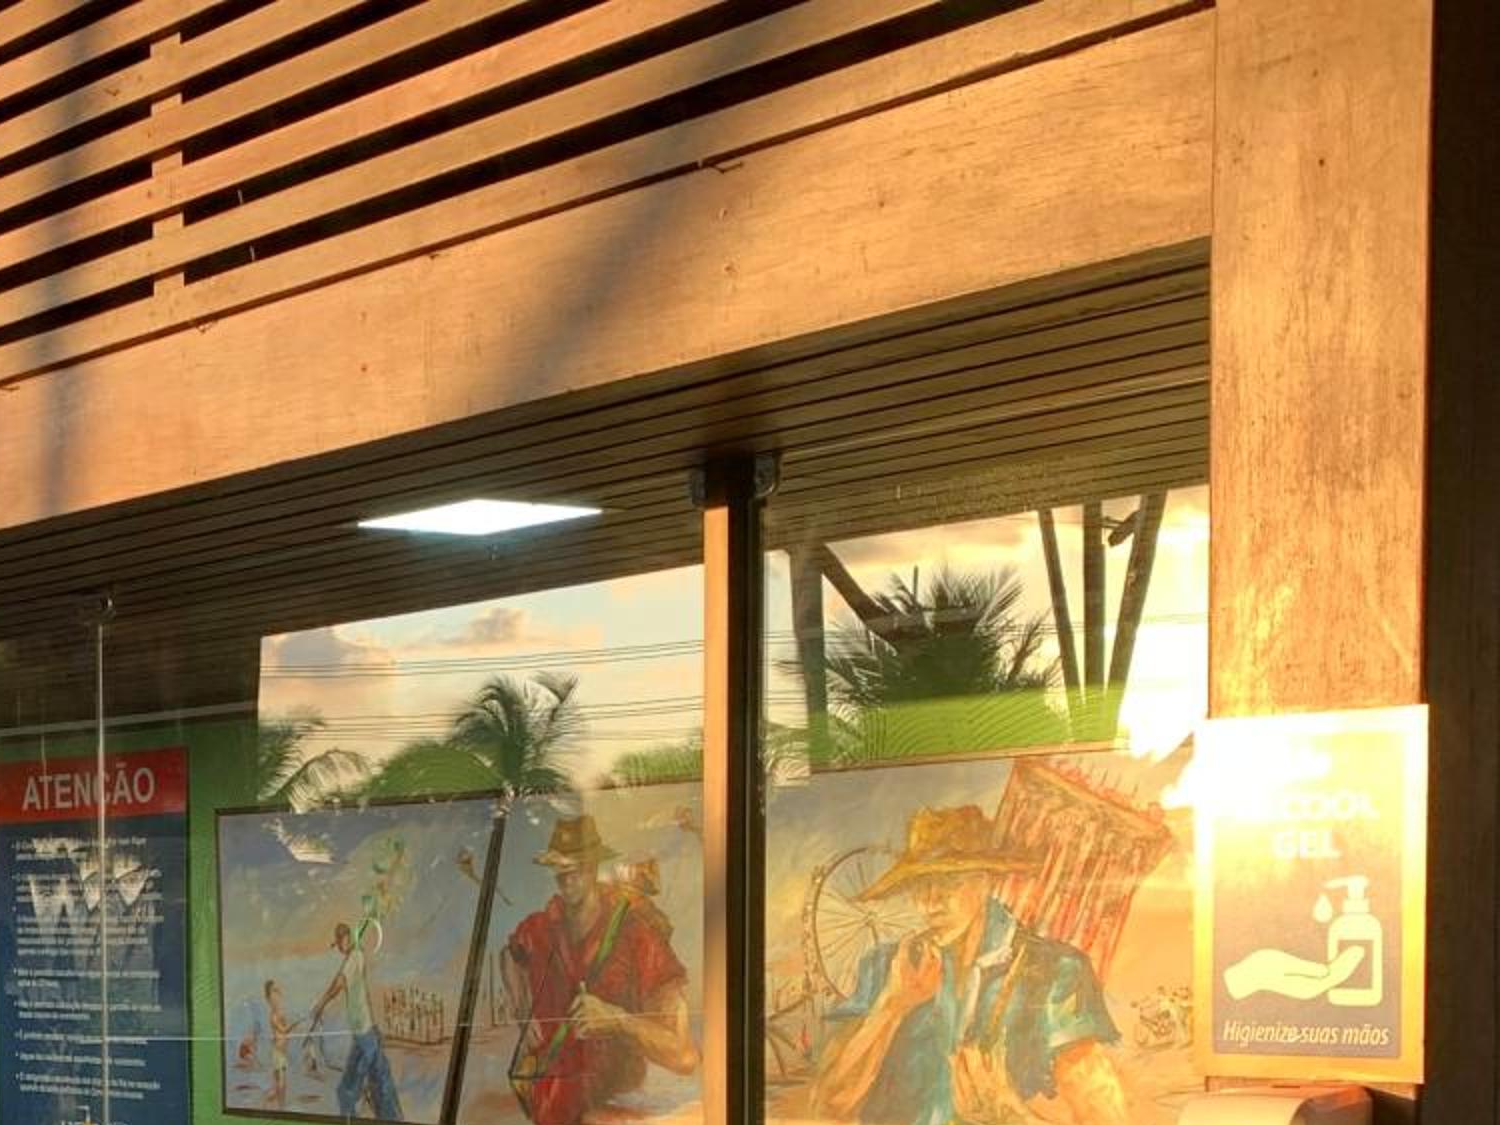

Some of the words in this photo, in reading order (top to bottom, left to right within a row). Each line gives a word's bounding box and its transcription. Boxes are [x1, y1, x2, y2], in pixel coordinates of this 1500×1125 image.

[22, 762, 156, 812] ATENÇÃO
[1274, 831, 1340, 860] GEL
[1300, 1025, 1339, 1045] suas
[1341, 1022, 1391, 1046] mãos
